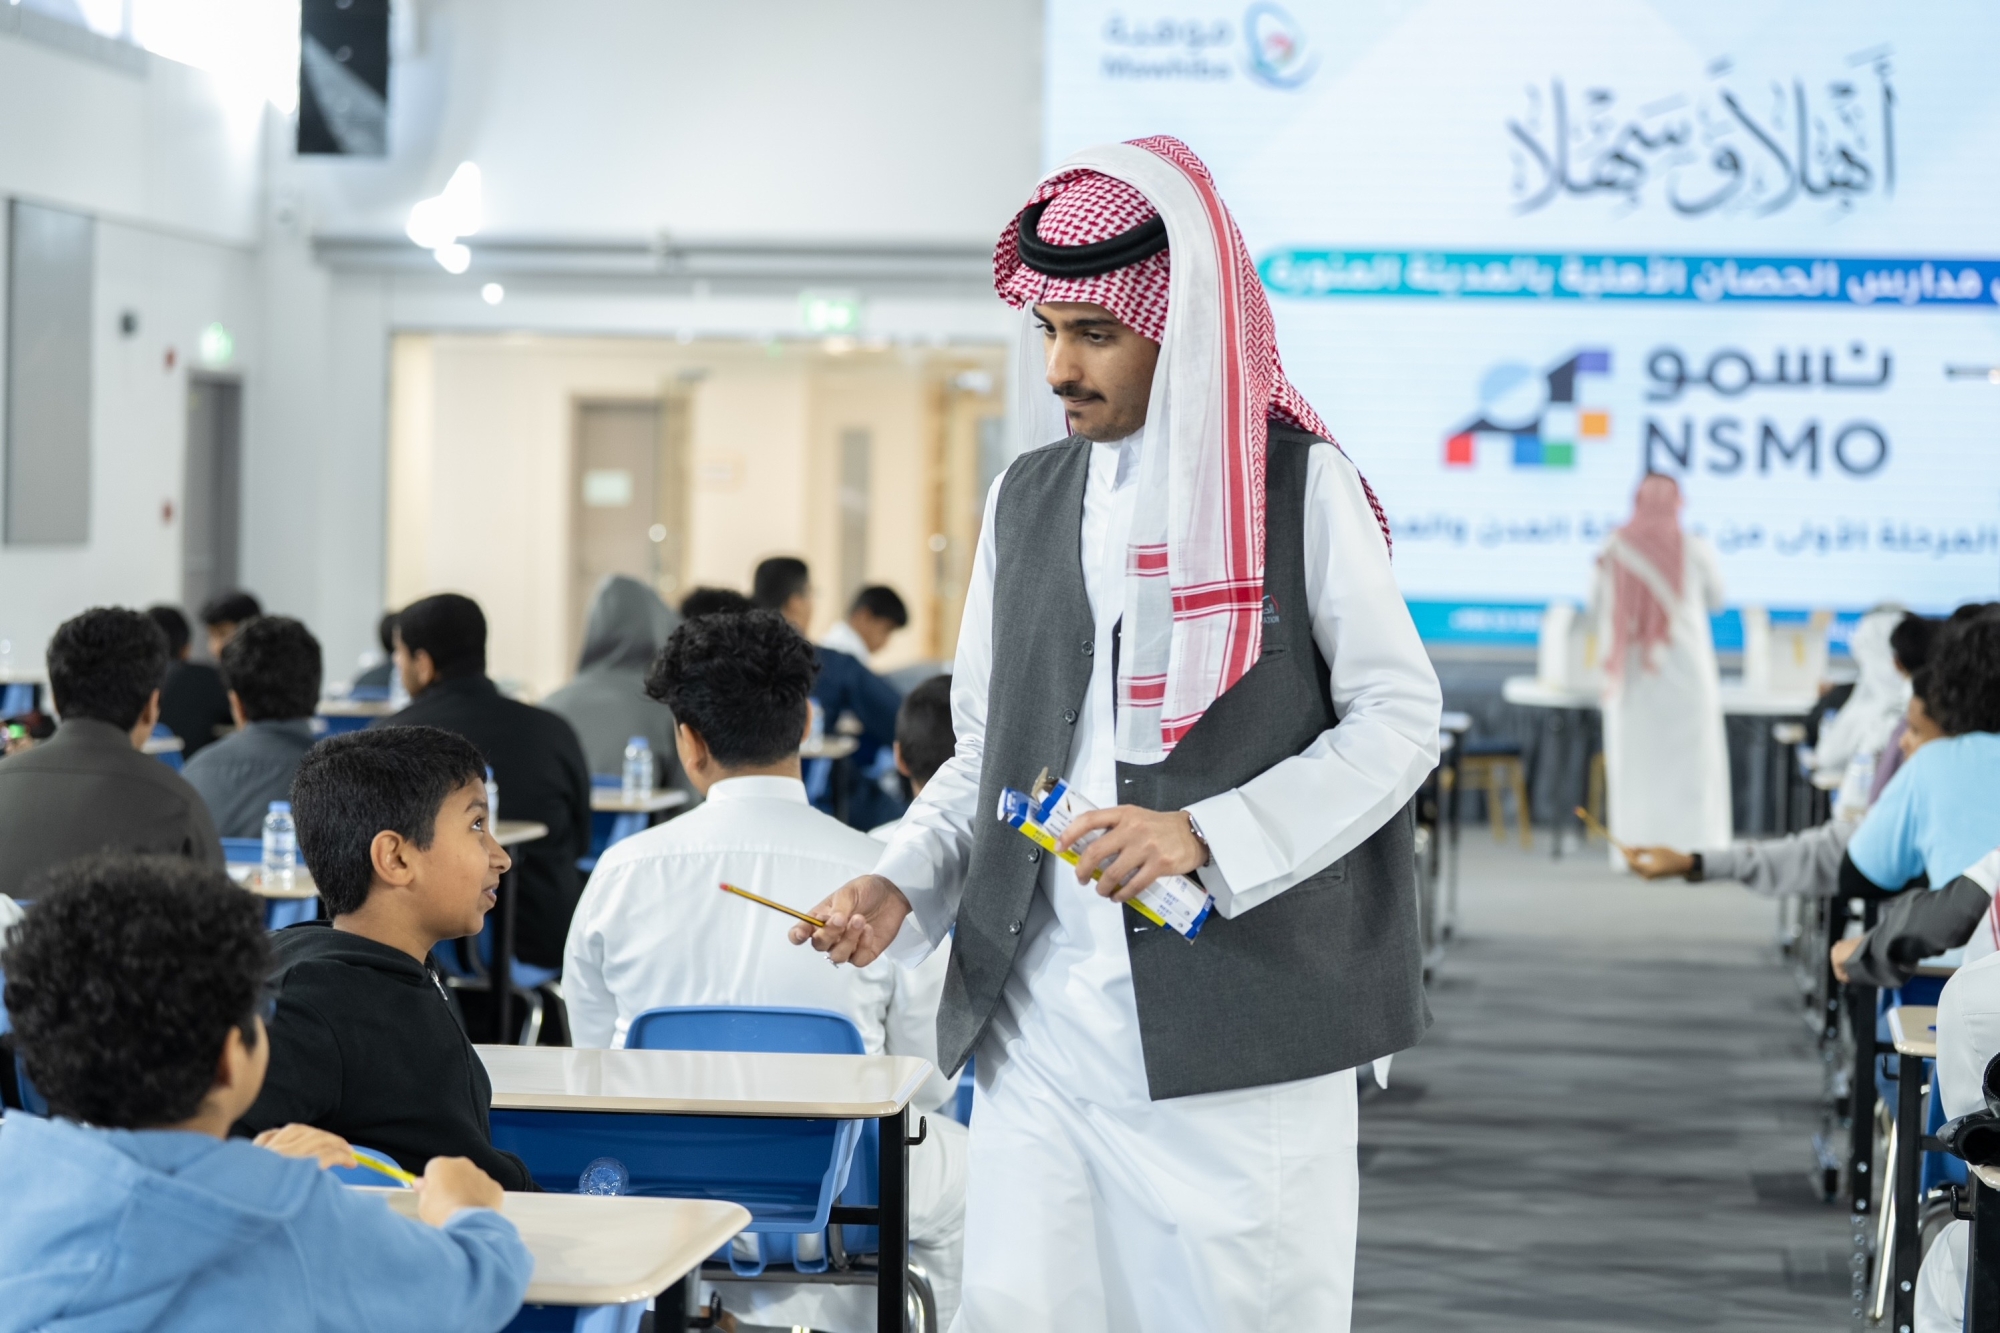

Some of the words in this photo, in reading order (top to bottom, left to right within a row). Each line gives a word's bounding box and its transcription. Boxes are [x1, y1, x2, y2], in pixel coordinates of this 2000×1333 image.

[1267, 253, 1401, 298] المنورة
[1404, 253, 1554, 299] بالمدينة
[1557, 254, 1687, 300] الأهلية
[1692, 258, 1839, 302] الحصان
[1846, 261, 1982, 303] مدارس
[1646, 342, 1890, 401] نسمو
[1647, 418, 1888, 474] NSMO
